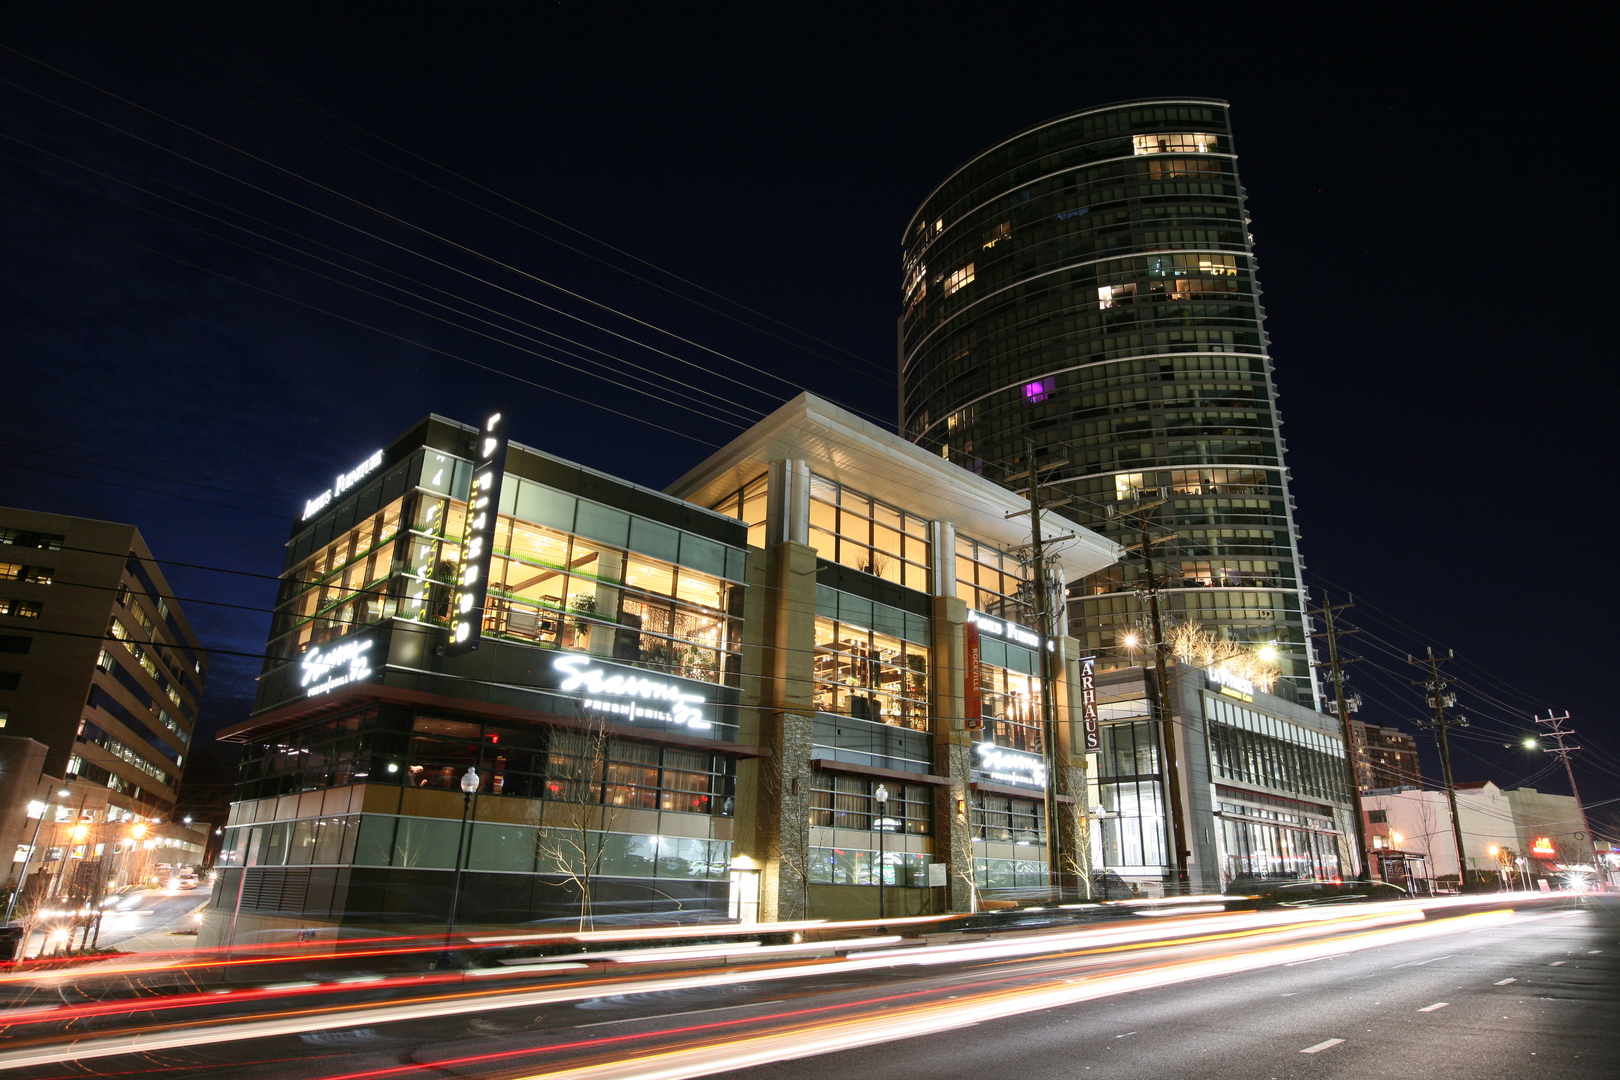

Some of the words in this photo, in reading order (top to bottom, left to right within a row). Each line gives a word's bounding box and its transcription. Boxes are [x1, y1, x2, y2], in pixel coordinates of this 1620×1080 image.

[456, 471, 492, 643] FITNESS
[457, 479, 481, 587] SIGNATURE
[449, 592, 464, 644] CLUB
[1006, 622, 1054, 652] FURNITE
[553, 654, 706, 703] Seasons
[972, 648, 980, 692] ROCKVILLE
[583, 698, 630, 714] FRESH
[635, 708, 673, 722] GRILL
[1081, 662, 1098, 748] ARHAUS
